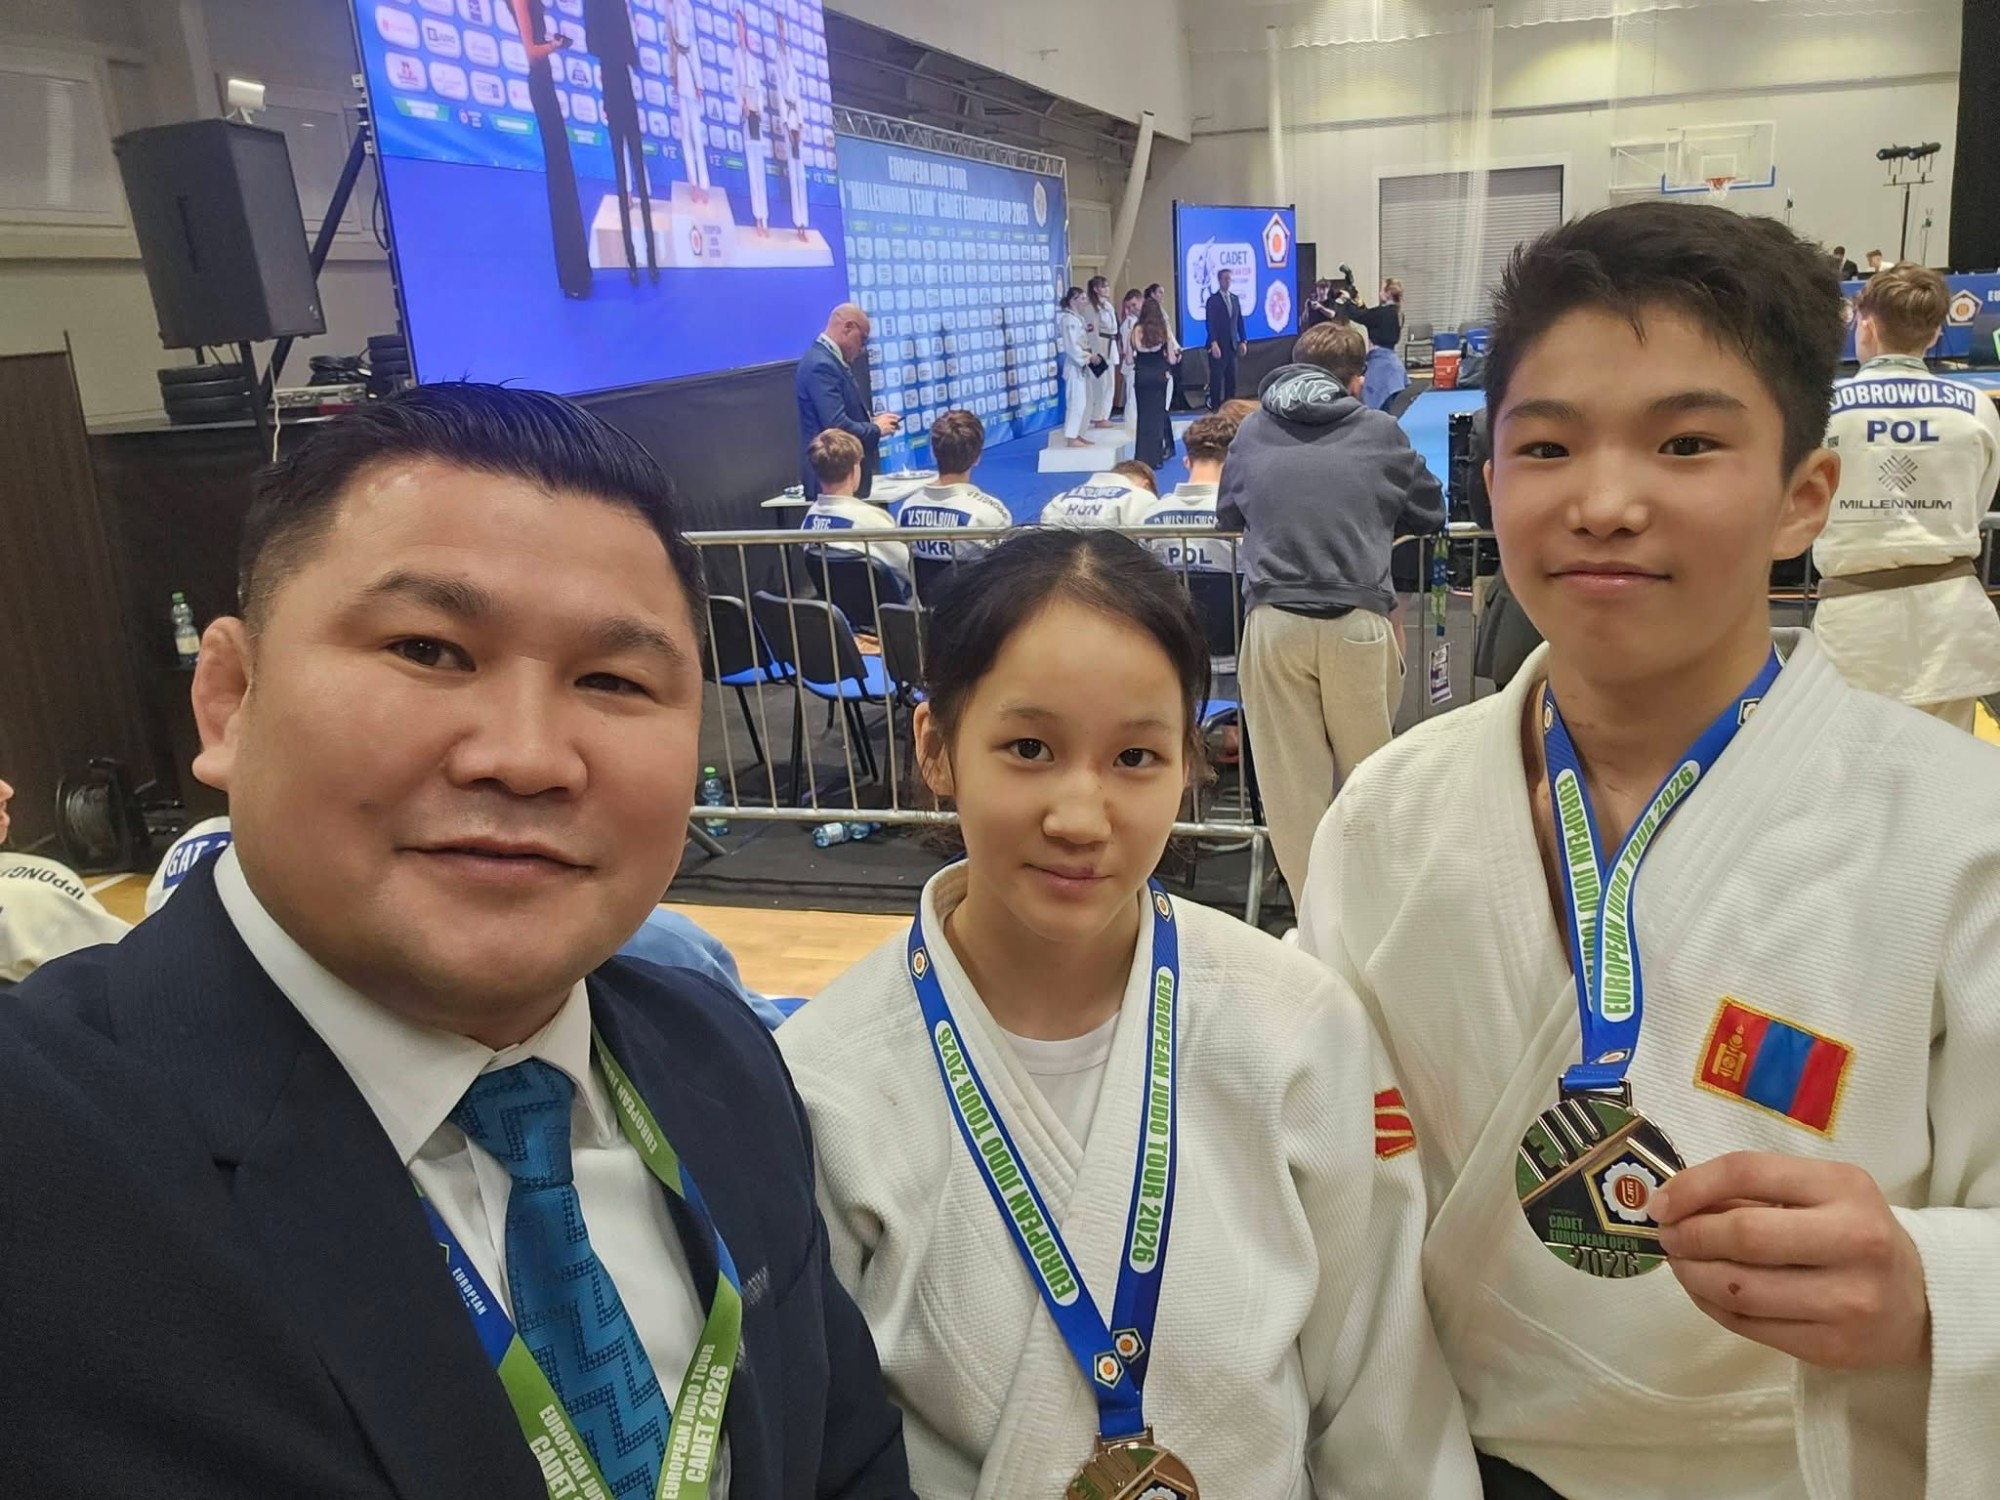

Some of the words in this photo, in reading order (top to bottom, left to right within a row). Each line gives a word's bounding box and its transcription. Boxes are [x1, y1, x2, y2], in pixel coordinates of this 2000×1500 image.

[1220, 251, 1248, 265] CADET
[1867, 420, 1940, 443] POL
[1066, 503, 1102, 516] HUN
[1840, 499, 1952, 510] MILLENNIUM
[916, 540, 953, 556] UKR
[1168, 547, 1213, 565] POL
[1557, 774, 1593, 866] EUROPEAN
[1654, 766, 1694, 820] 2026
[1622, 814, 1656, 868] TOUR
[1572, 866, 1600, 913] JUDO
[1606, 867, 1630, 922] JUDO
[1604, 911, 1632, 1014] EUROPEAN
[1153, 974, 1173, 1078] EUROPEAN
[937, 1027, 968, 1083] 2026
[616, 1084, 658, 1154] EUROPEAN
[955, 1080, 994, 1139] TOUR
[1149, 1075, 1170, 1137] JUDO
[980, 1136, 1024, 1191] JUDO
[1142, 1140, 1169, 1199] TOUR
[1009, 1188, 1076, 1299] EUROPEAN
[1131, 1202, 1162, 1264] 2026
[1548, 1215, 1583, 1231] CADET
[1549, 1230, 1607, 1248] EUROPEAN
[1609, 1236, 1639, 1252] OPEN
[1569, 1245, 1640, 1279] 2026
[452, 1267, 488, 1316] EUROPEAN
[699, 1365, 728, 1419] 2026
[539, 1404, 591, 1480] EUROPEAN
[662, 1425, 693, 1500] EUROPEAN
[679, 1384, 702, 1424] JUDO
[691, 1344, 715, 1382] TOUR
[529, 1435, 577, 1499] CADET
[686, 1421, 716, 1483] CADET
